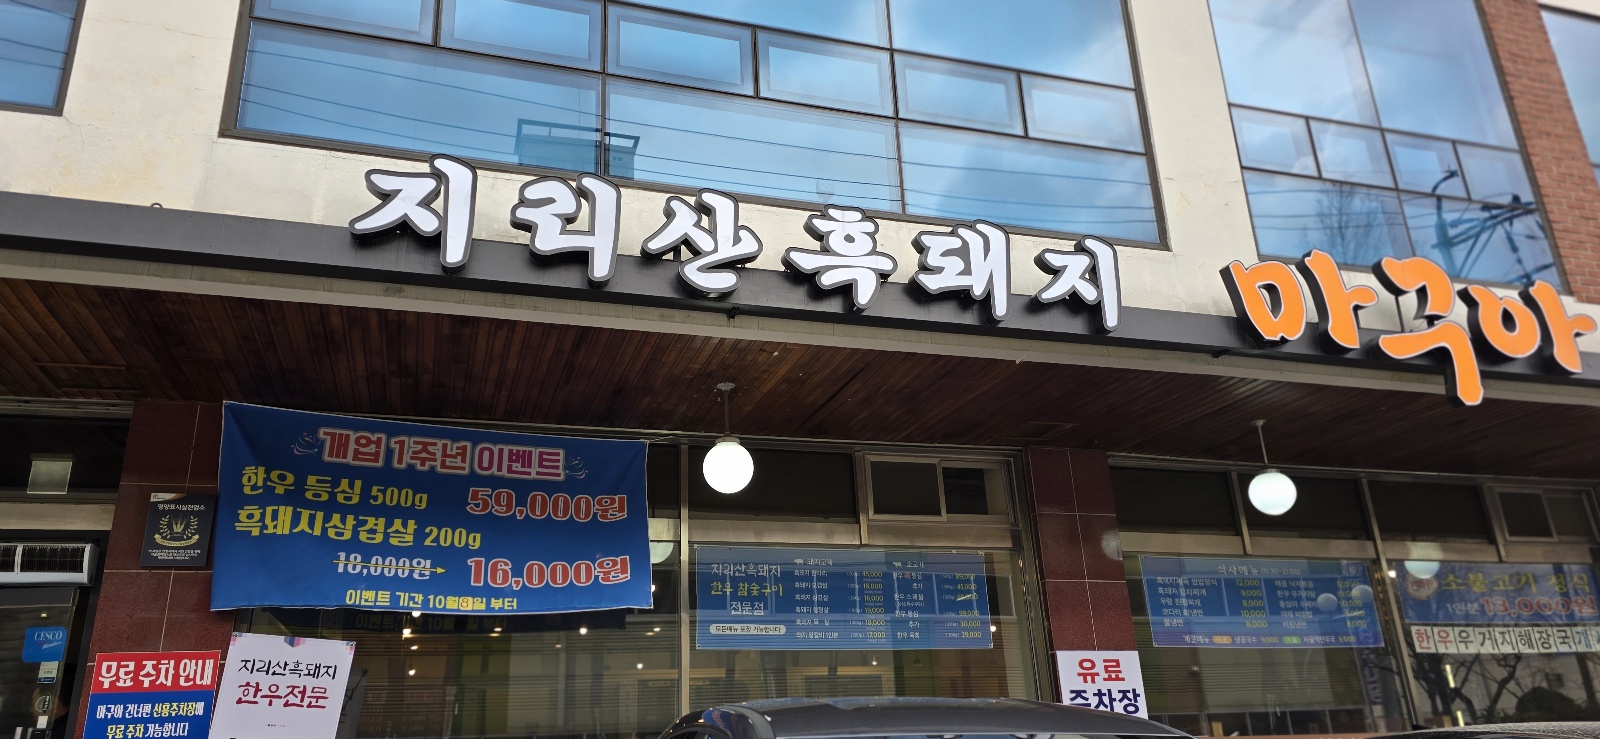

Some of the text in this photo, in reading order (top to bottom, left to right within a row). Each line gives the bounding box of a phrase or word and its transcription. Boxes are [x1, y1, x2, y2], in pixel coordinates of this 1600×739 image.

[349, 154, 1598, 405] 지리산흑돼지 마구아
[319, 427, 566, 479] 개업 1주년 이벤트
[241, 464, 628, 522] 한우 등심 500g 59,000원
[234, 505, 482, 549] 흑돼지삼겹살 200g
[336, 551, 631, 589] 18,000원 16,000원
[711, 563, 781, 578] 지리산흑돼지
[1218, 565, 1259, 576] 식사메뉴
[710, 581, 783, 597] 한우 참숯구이
[1443, 573, 1537, 593] 소불고기
[1548, 573, 1592, 593] 정식
[345, 589, 391, 606] 이벤트
[396, 591, 424, 608] 기간
[490, 597, 517, 610] 부터
[730, 601, 765, 616] 전문점
[1447, 596, 1599, 617] 1인분 13,000원
[34, 631, 63, 641] CESCO
[98, 658, 214, 689] 무료 주차 안내
[238, 658, 337, 680] 지리산흑돼지
[1077, 658, 1126, 684] 유료
[236, 681, 329, 709] 한우전문
[96, 701, 205, 719] 마구아 건너편 신흥주차장에
[106, 722, 189, 739] 무료 주차 가능합니다
